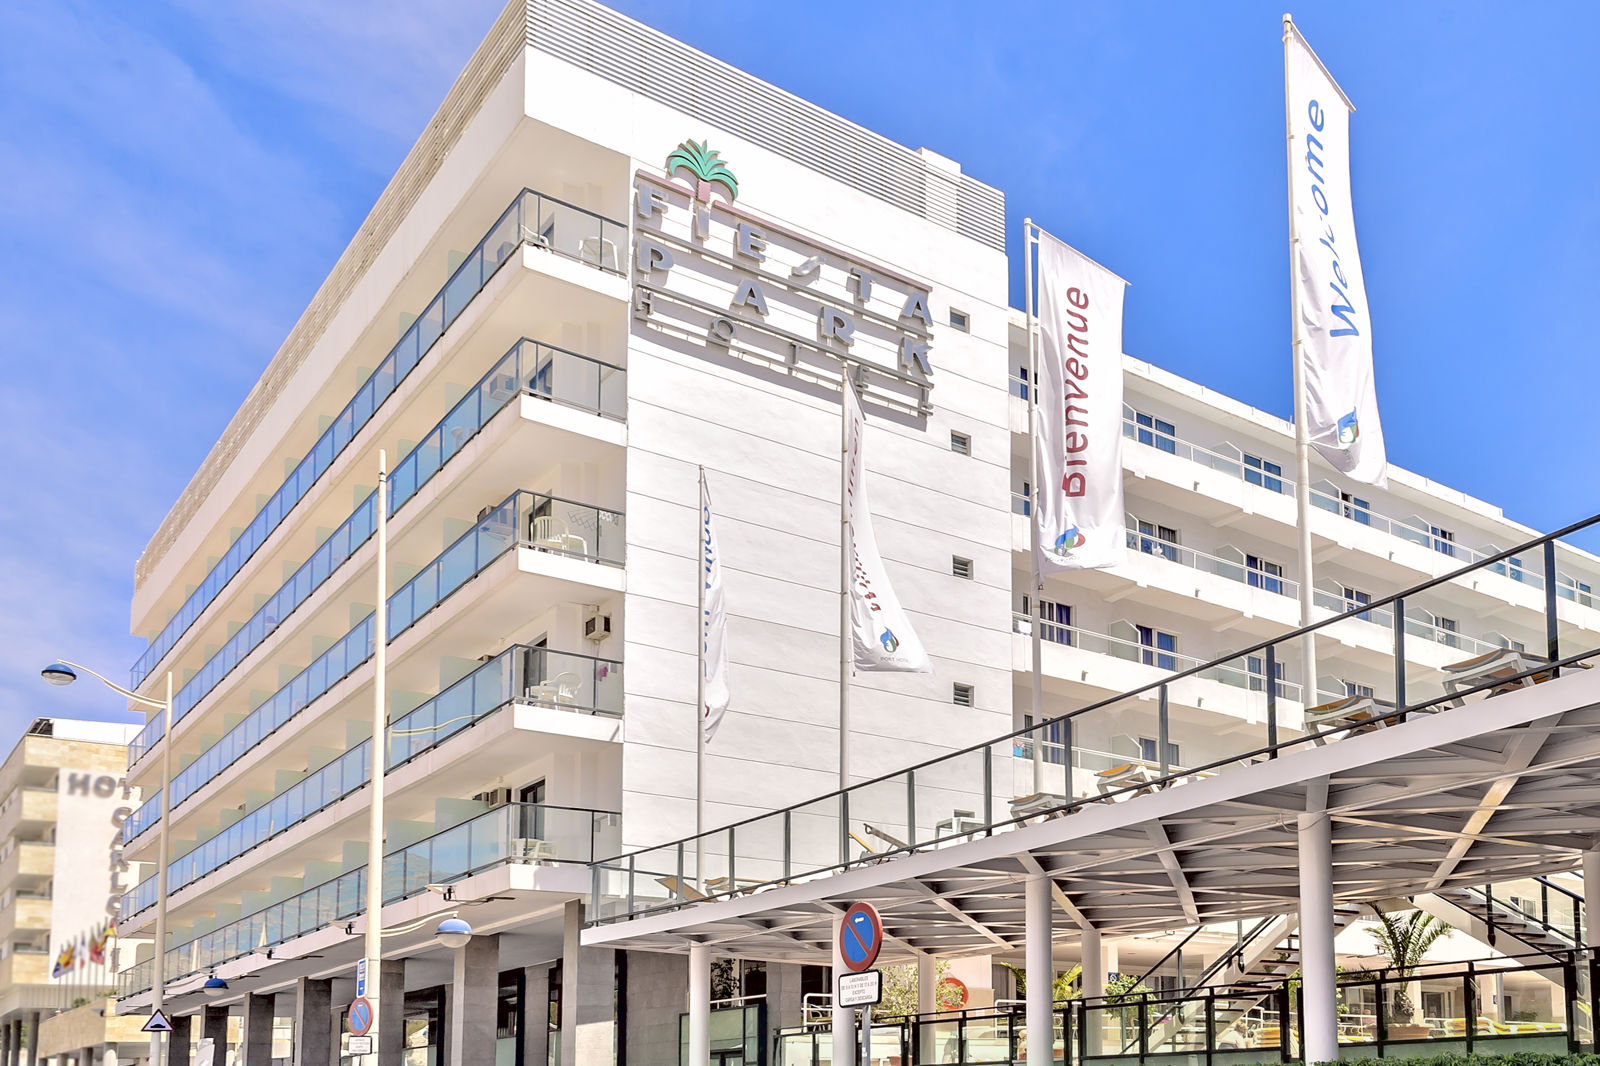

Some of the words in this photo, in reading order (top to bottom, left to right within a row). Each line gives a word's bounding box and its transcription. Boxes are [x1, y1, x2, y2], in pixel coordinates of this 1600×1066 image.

[636, 183, 933, 327] FIESTA
[636, 238, 934, 377] PARK
[635, 287, 934, 410] HOTEL
[1063, 286, 1090, 498] Bienvenue
